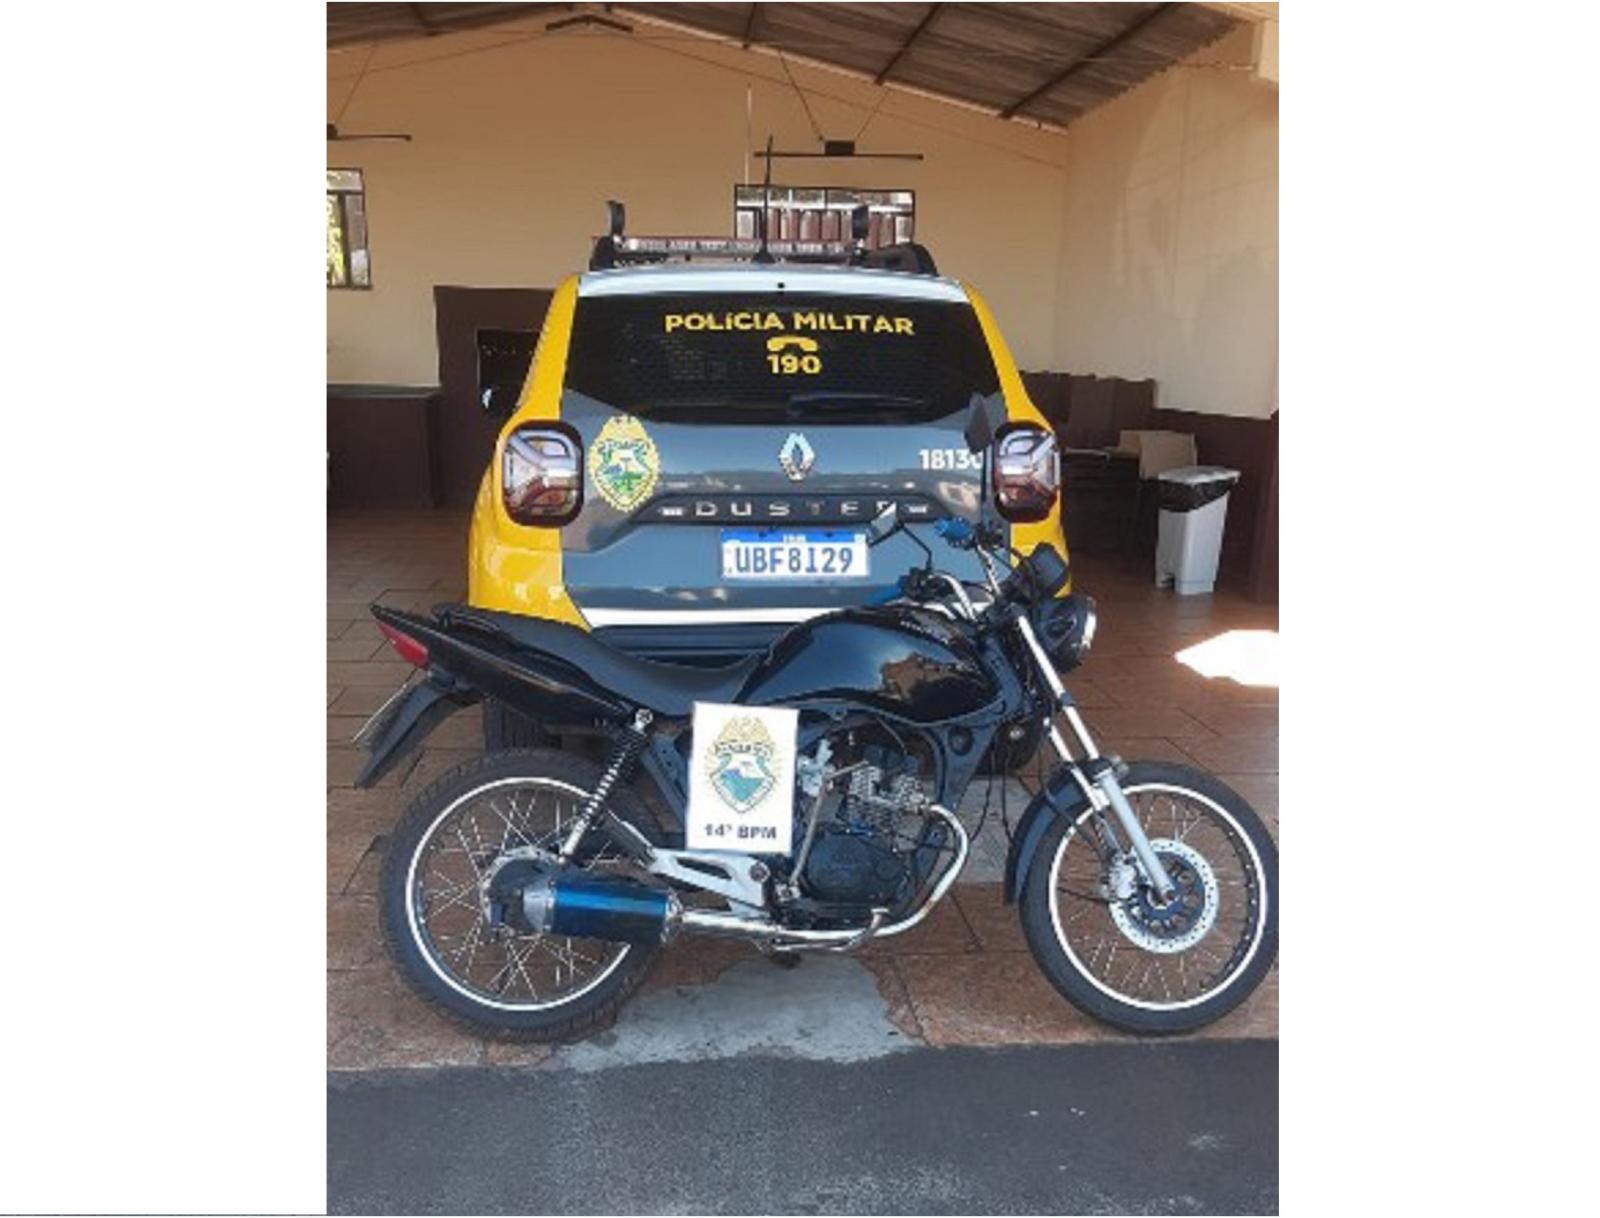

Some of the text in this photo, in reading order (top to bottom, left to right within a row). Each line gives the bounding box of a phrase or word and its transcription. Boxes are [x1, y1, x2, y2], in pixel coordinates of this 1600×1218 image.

[664, 312, 914, 335] POLÍCIA MILITAR
[766, 354, 822, 374] 190
[736, 825, 777, 839] BPM
